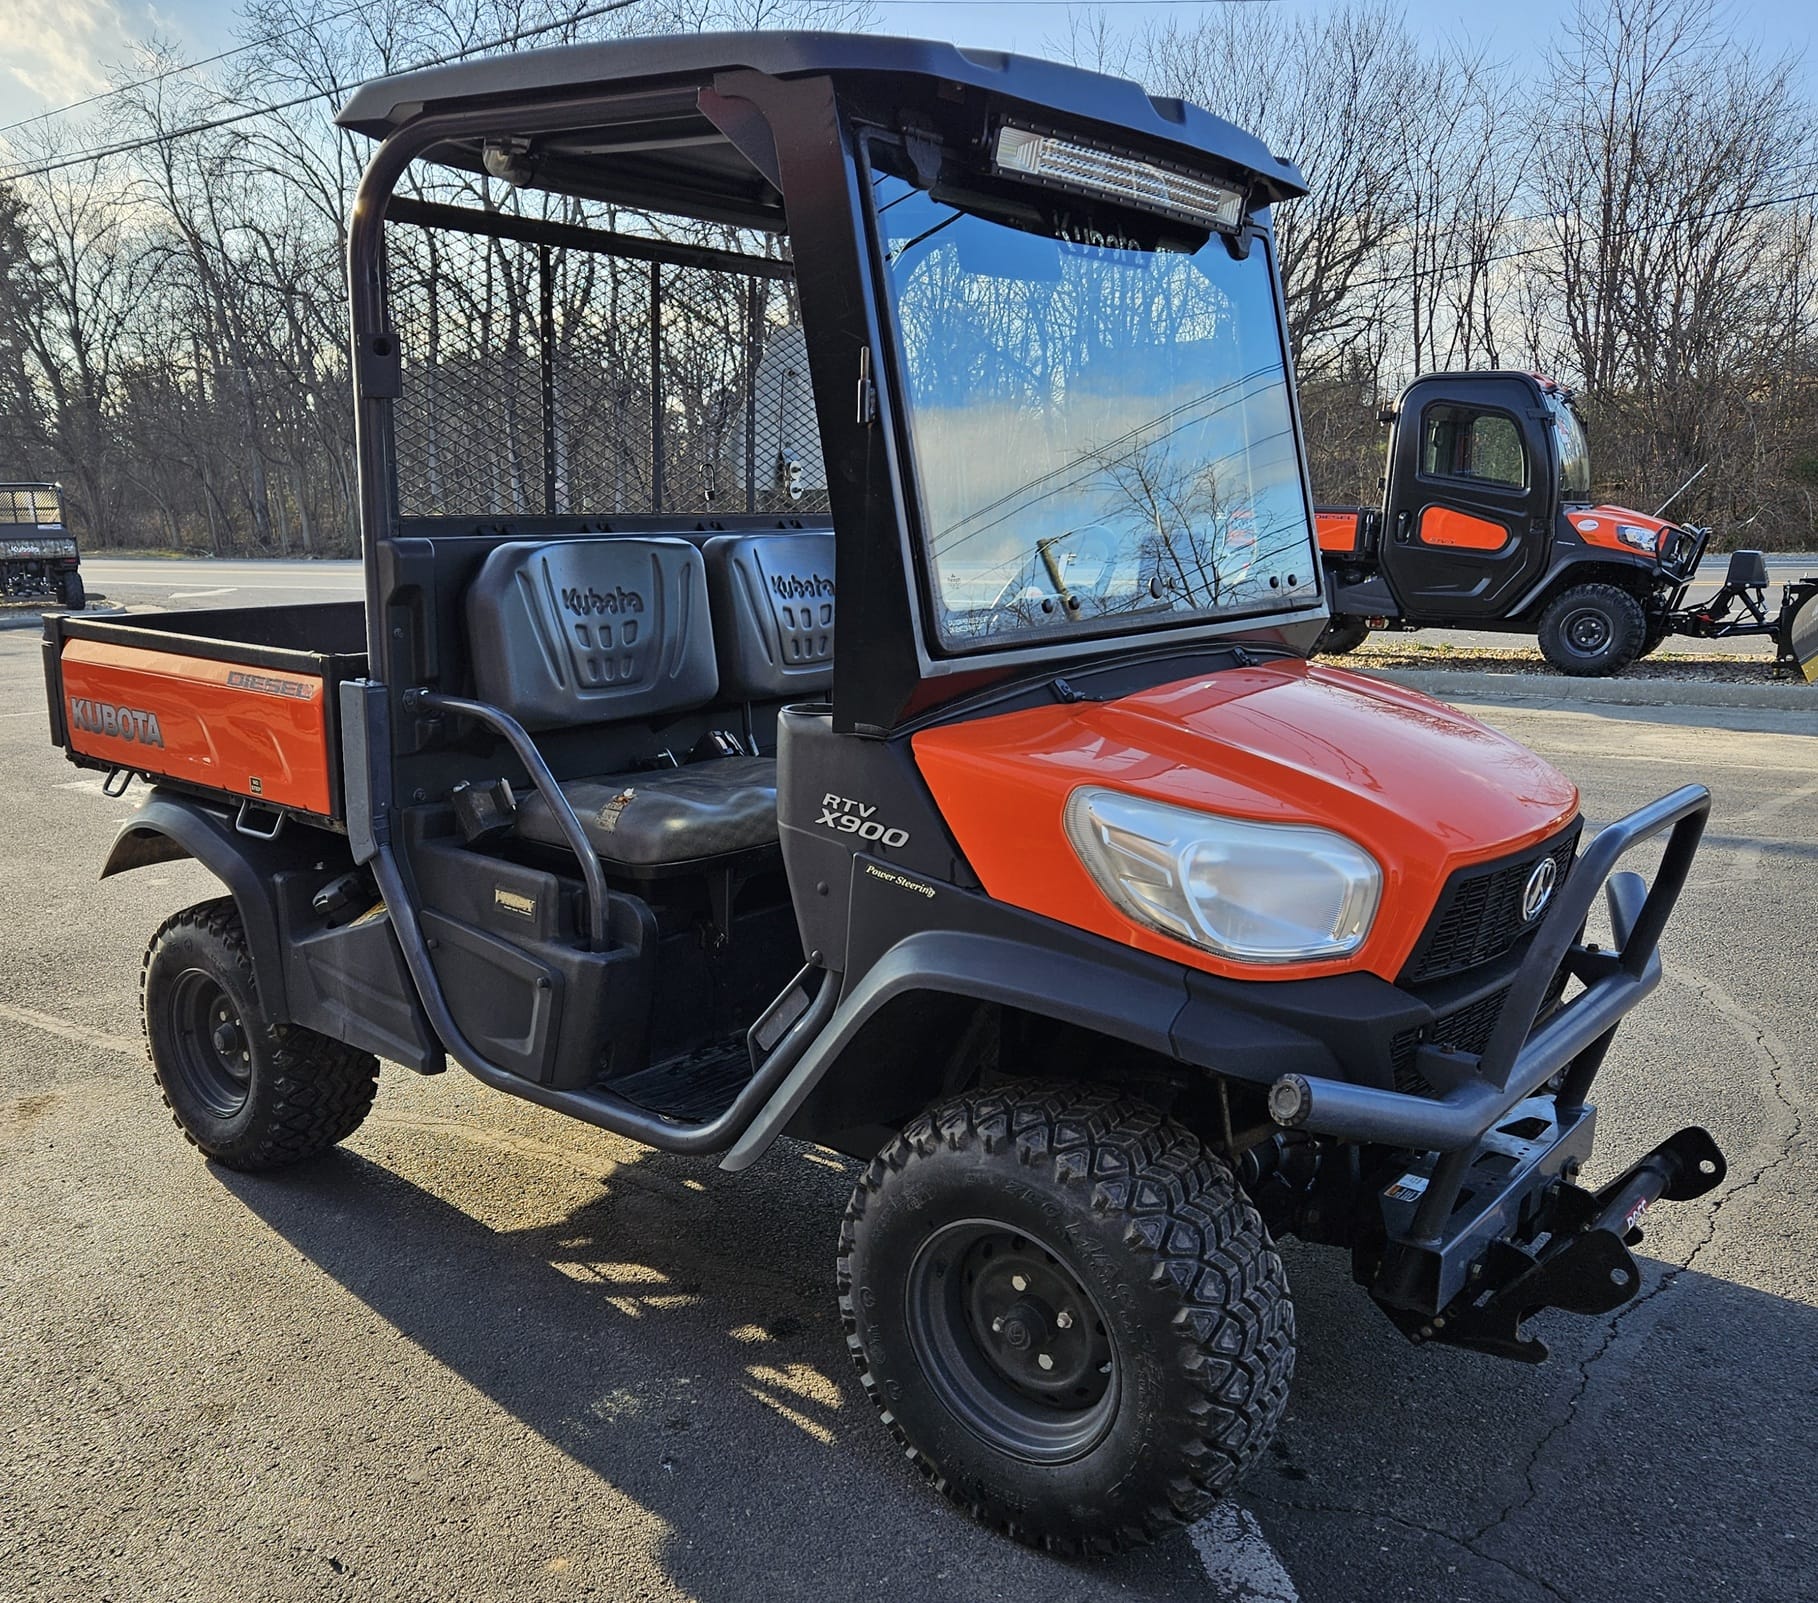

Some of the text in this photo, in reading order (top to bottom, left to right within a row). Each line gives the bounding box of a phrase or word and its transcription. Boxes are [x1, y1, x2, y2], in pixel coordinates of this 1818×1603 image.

[561, 585, 644, 616] Kubota
[771, 573, 835, 600] Kubota
[227, 671, 314, 700] DIESEL
[71, 696, 164, 748] KUBOTA
[822, 792, 877, 818] RTV
[814, 807, 910, 848] X900
[865, 865, 936, 898] Power Steering
